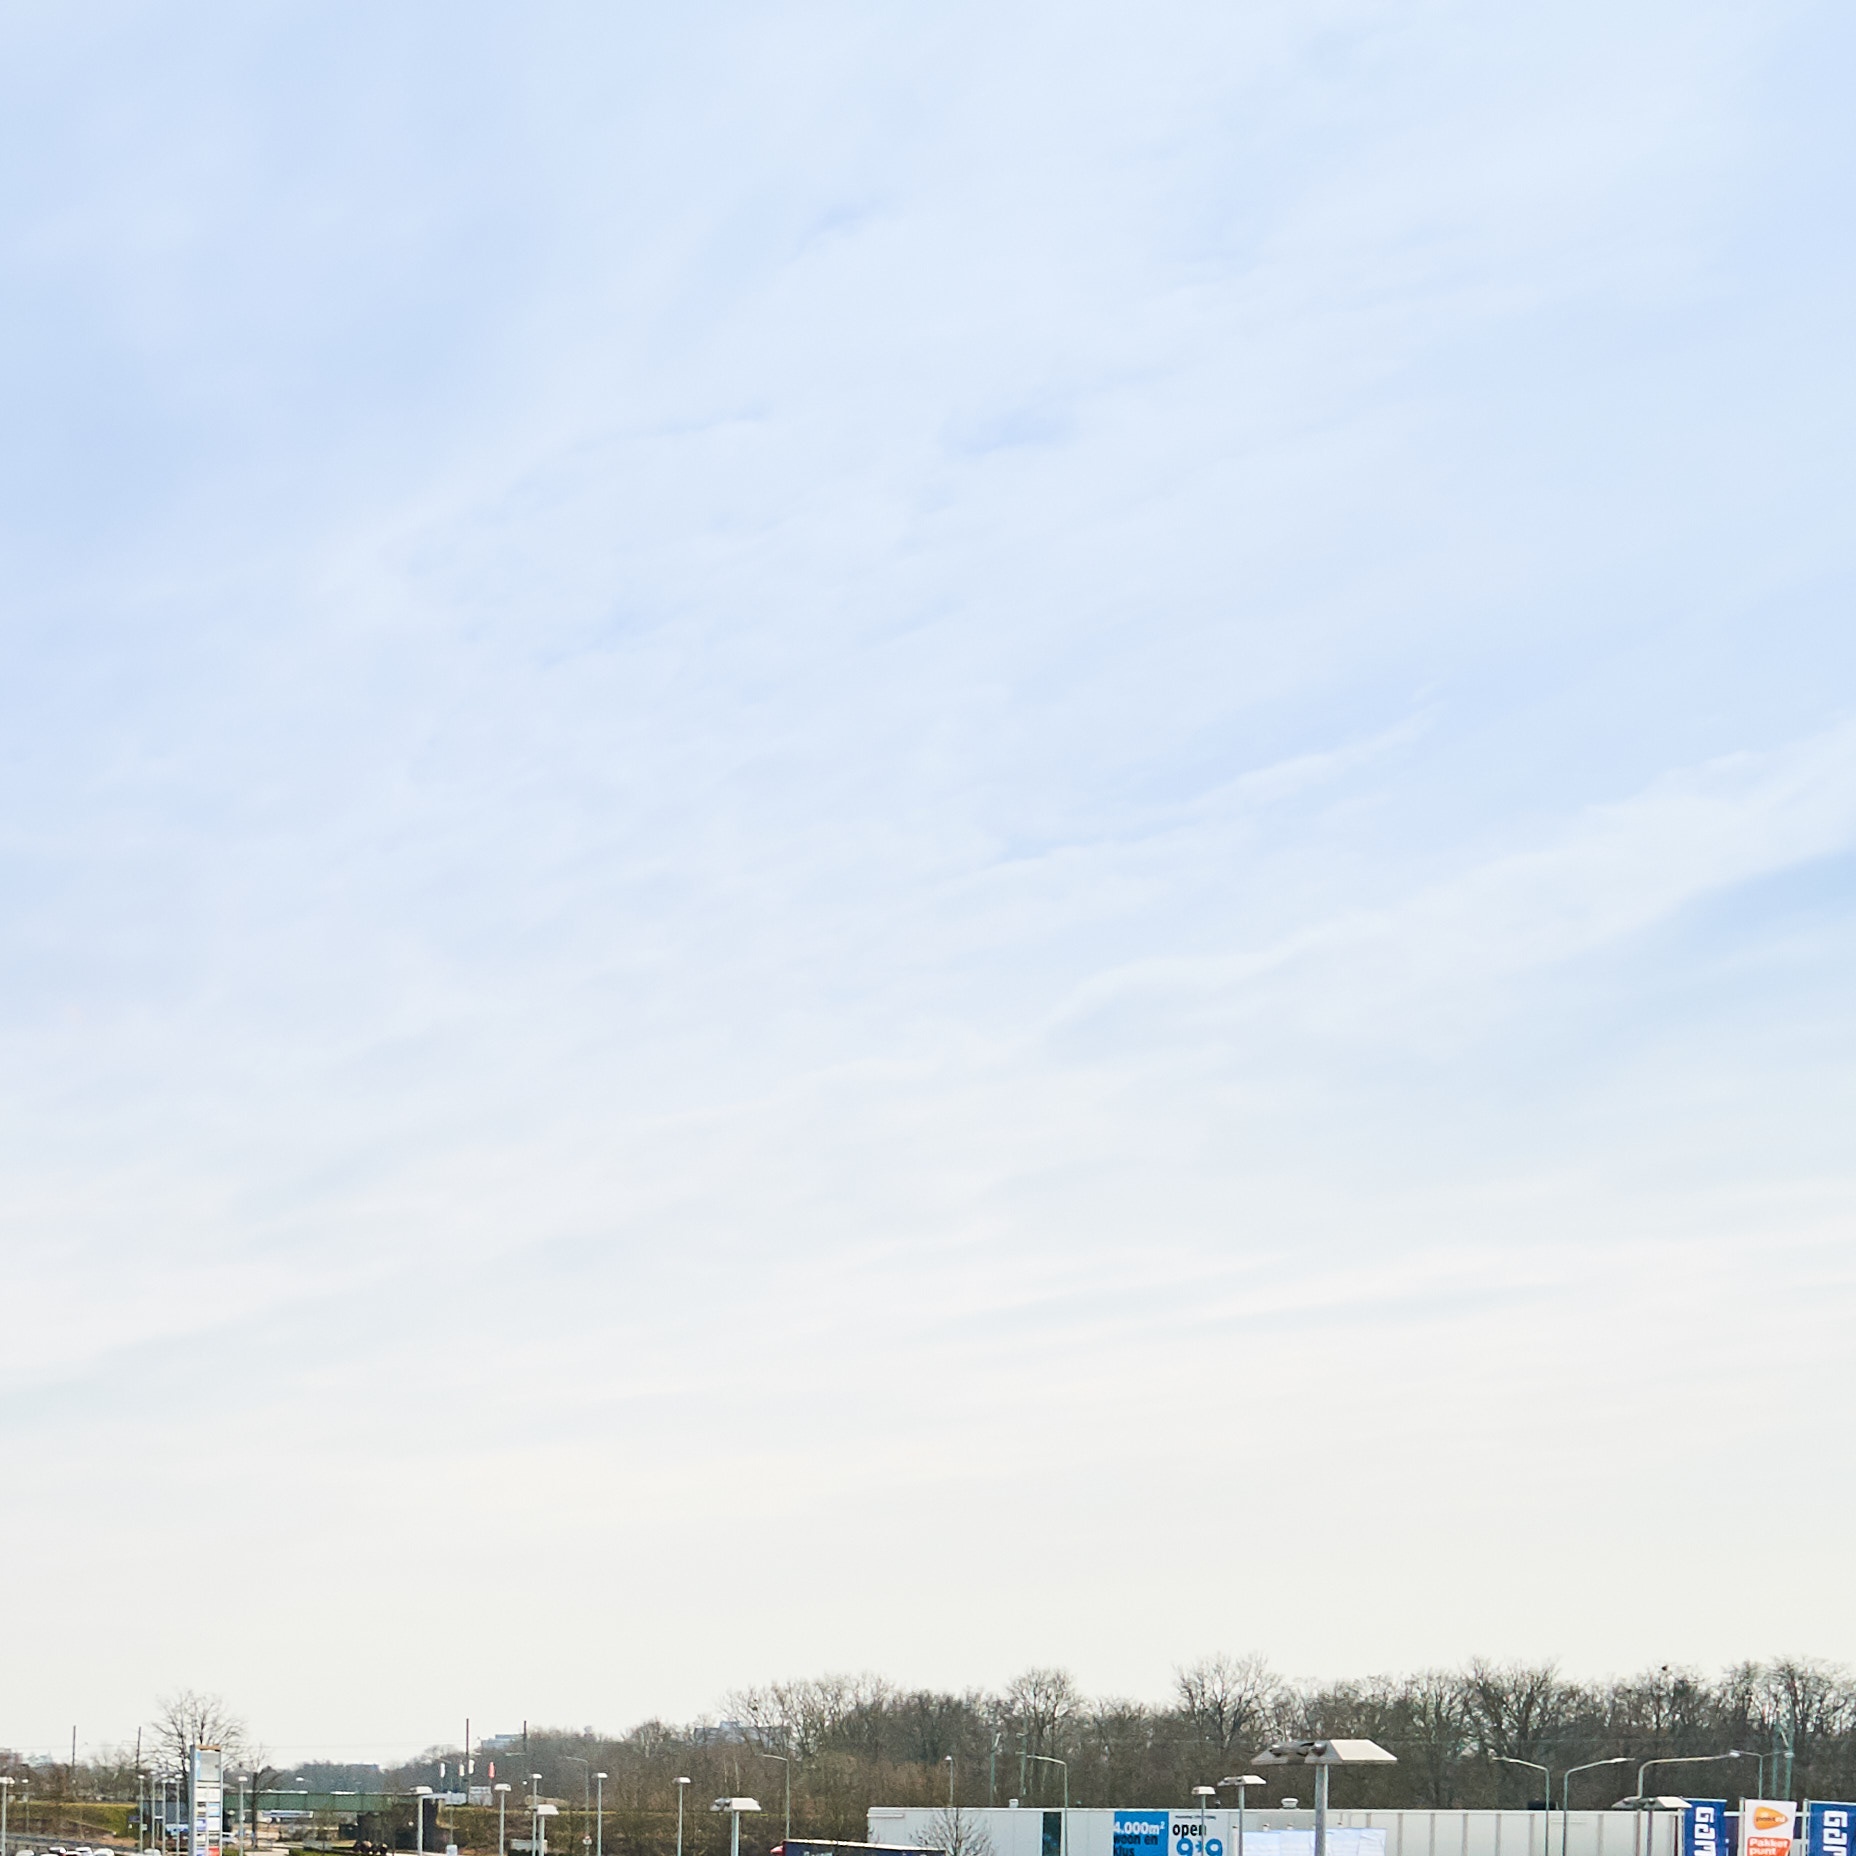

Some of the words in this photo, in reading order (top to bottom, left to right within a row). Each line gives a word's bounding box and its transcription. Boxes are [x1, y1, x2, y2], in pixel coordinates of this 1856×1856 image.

[1172, 1822, 1207, 1838] open
[1143, 1835, 1158, 1846] en
[1749, 1837, 1789, 1848] Pakket
[1749, 1847, 1777, 1856] punt
